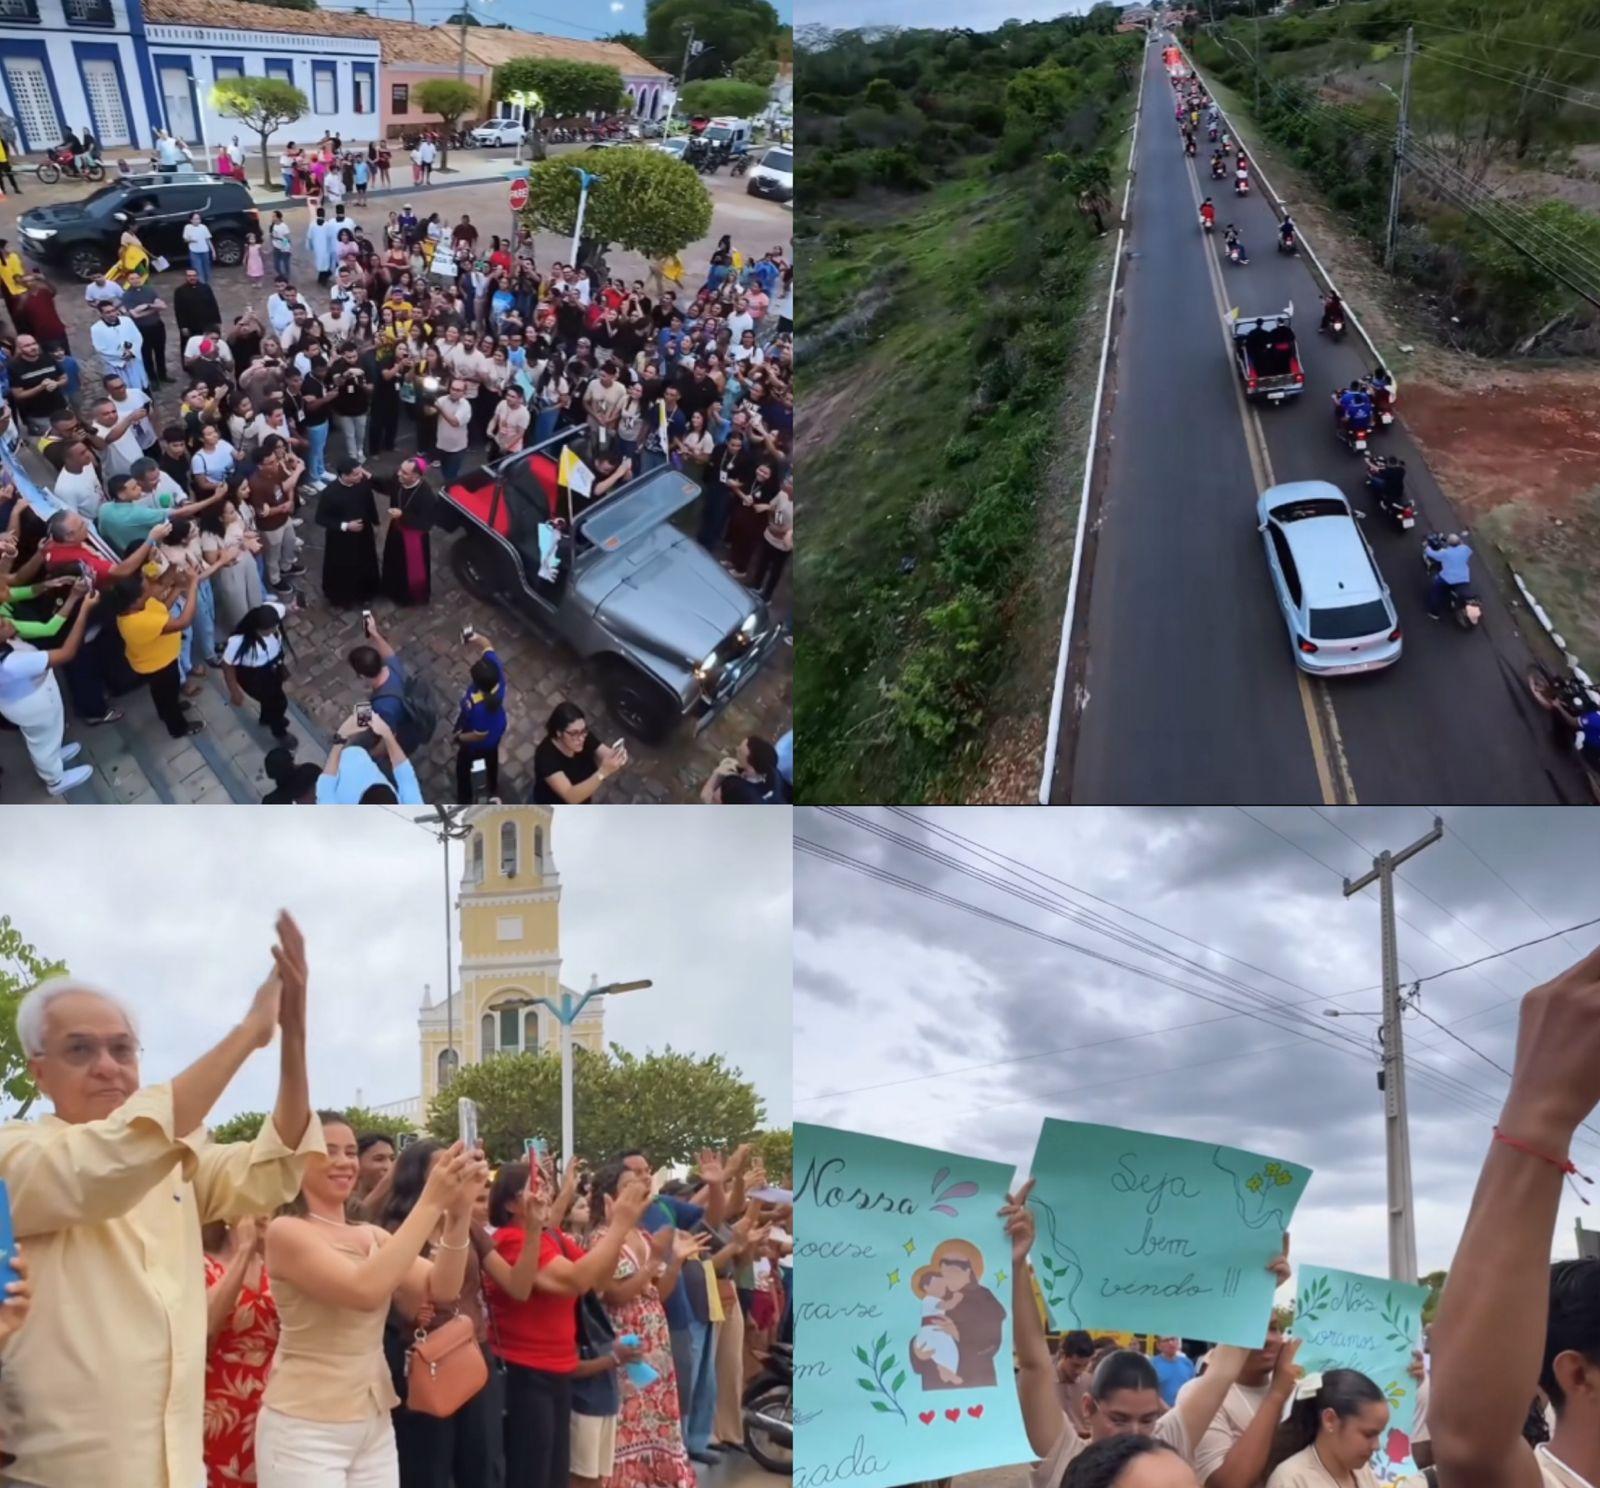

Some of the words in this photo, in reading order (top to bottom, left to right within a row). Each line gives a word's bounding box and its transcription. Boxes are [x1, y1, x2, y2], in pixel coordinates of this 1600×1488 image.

[792, 1157, 919, 1215] Nossa
[1111, 1152, 1200, 1214] Seja
[1125, 1217, 1197, 1257] bem
[1099, 1273, 1213, 1297] vindo
[1330, 1280, 1377, 1312] Nós
